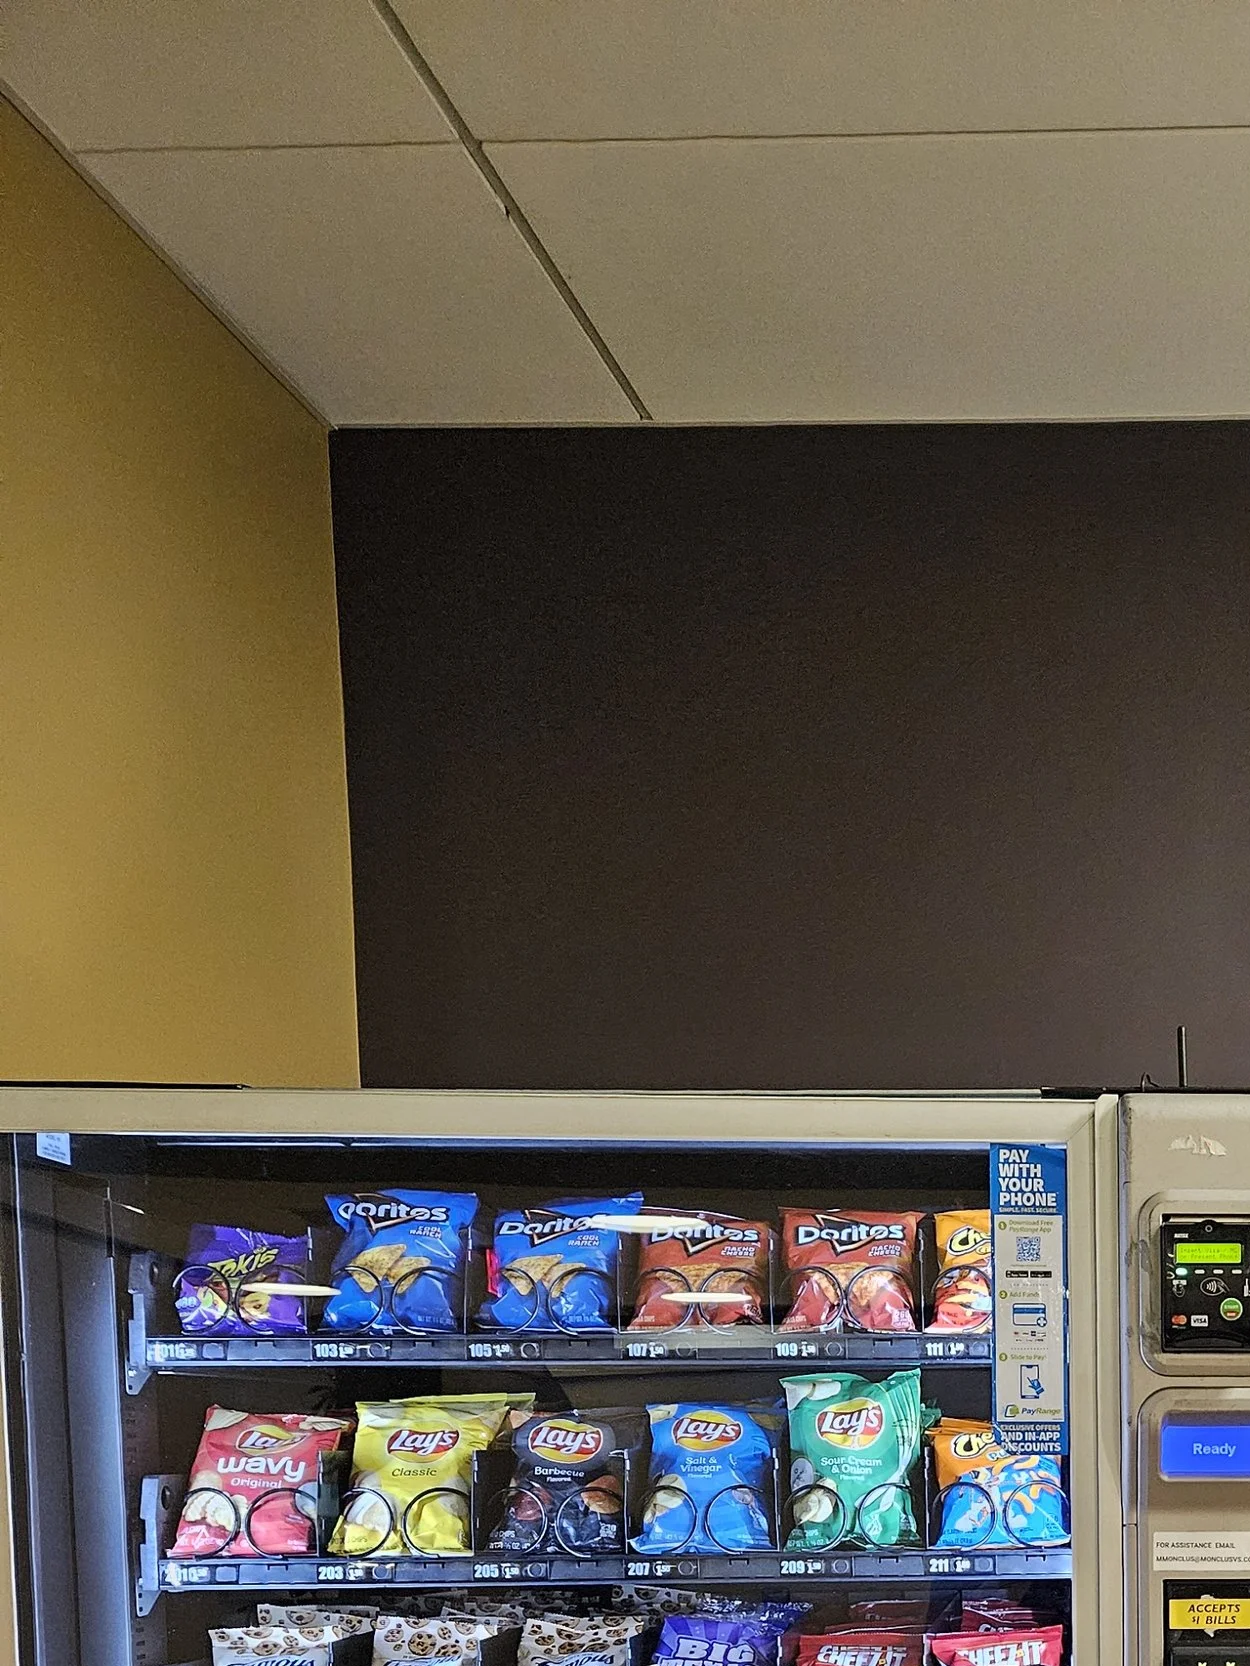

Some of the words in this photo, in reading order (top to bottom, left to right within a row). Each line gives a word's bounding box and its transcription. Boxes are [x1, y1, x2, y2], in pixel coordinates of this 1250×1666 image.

[999, 1149, 1029, 1163] PAY
[998, 1164, 1042, 1178] WITH
[998, 1178, 1045, 1192] YOUR
[999, 1192, 1057, 1206] PHONE
[797, 1223, 905, 1245] Doritos
[1021, 1407, 1062, 1416] PayRange
[819, 1404, 883, 1436] Lay's
[676, 1417, 743, 1444] Lay's
[1001, 1432, 1024, 1441] AND
[1025, 1432, 1060, 1441] IN-APP
[389, 1429, 459, 1456] Lay's
[531, 1424, 600, 1458] Lay's
[1193, 1443, 1236, 1457] Ready
[685, 1456, 706, 1465] Salt
[707, 1456, 718, 1465] &
[820, 1456, 846, 1467] Sour
[848, 1455, 883, 1467] Cream
[215, 1455, 306, 1483] wavy
[391, 1467, 438, 1477] Classic
[534, 1465, 585, 1478] Barbecue
[679, 1463, 723, 1475] Vinegar
[831, 1465, 840, 1475] &
[842, 1464, 873, 1475] Onion
[230, 1477, 283, 1489] Original
[1188, 1604, 1241, 1613] ACCEPTS
[1191, 1616, 1200, 1625] $1
[1205, 1616, 1237, 1625] BILLS
[677, 1637, 756, 1662] BIG
